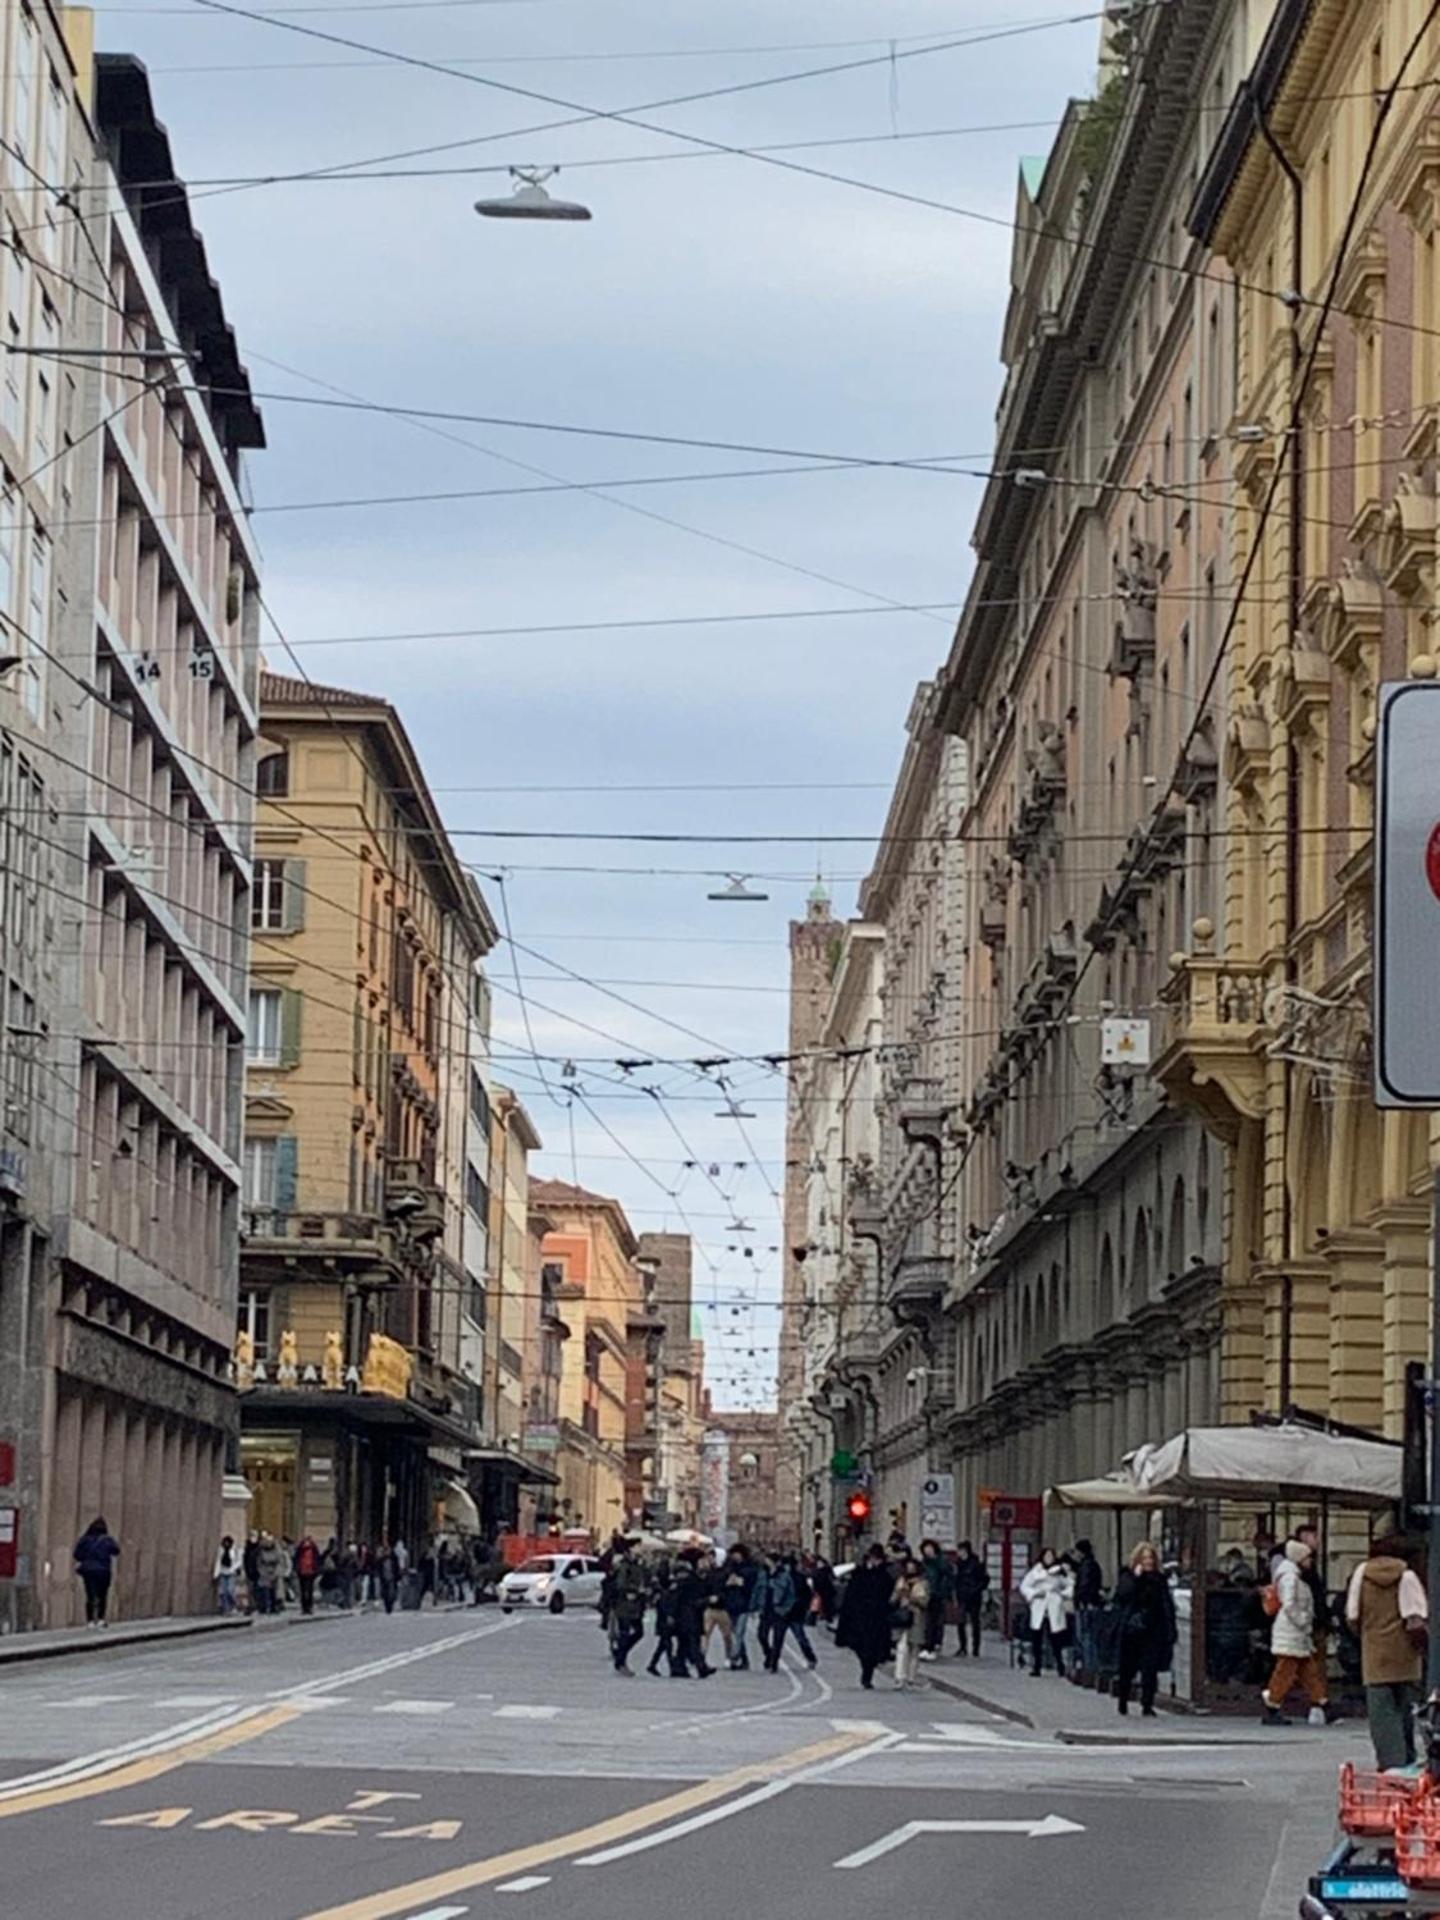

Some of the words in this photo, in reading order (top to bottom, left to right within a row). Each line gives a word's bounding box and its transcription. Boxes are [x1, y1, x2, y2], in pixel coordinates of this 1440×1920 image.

[135, 662, 161, 680] 14
[188, 661, 211, 678] 15
[345, 1790, 422, 1810] T
[93, 1807, 463, 1840] AREA
